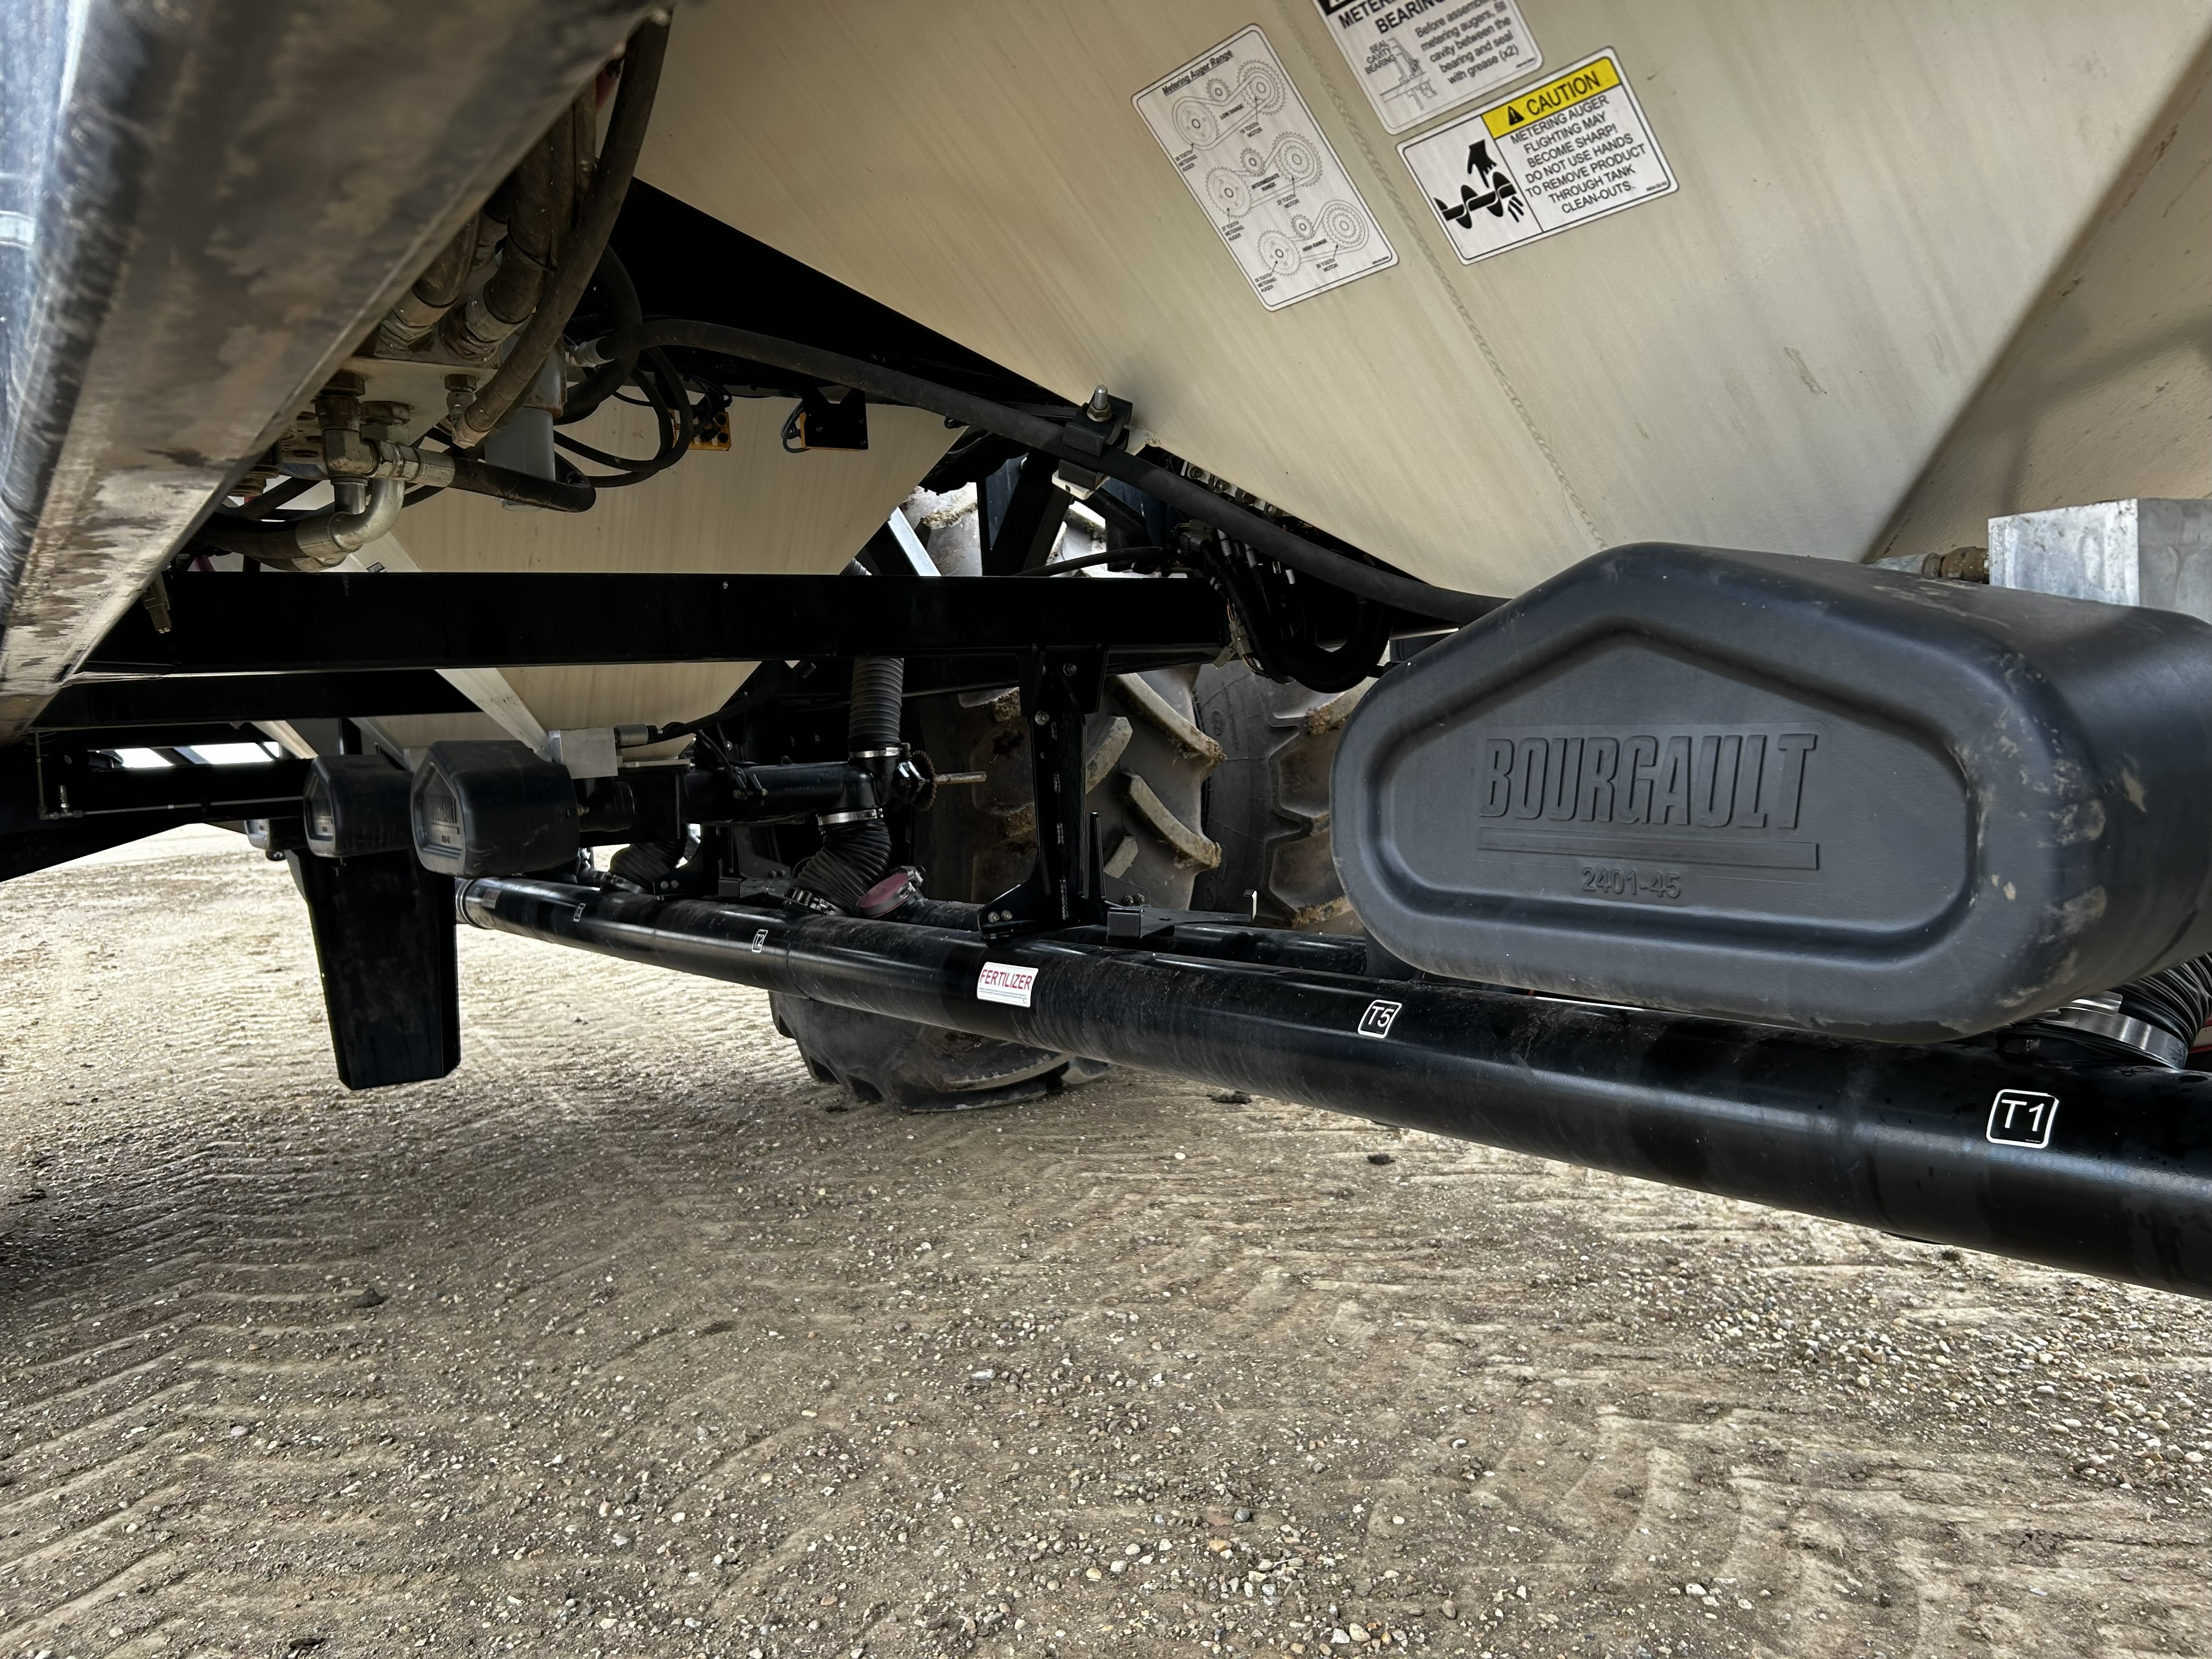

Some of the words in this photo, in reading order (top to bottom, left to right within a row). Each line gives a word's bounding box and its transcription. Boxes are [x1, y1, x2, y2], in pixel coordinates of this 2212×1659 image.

[1375, 0, 1444, 34] BEARIN
[1414, 18, 1446, 38] Before
[1367, 48, 1391, 64] CAVITY
[1369, 40, 1389, 53] SEAL
[1420, 27, 1460, 52] metering
[1429, 44, 1455, 63] cavity
[1454, 25, 1495, 49] between
[1493, 16, 1511, 30] the
[1438, 52, 1475, 73] bearing
[1474, 40, 1493, 57] and
[1493, 29, 1514, 47] seal
[1162, 75, 1190, 95] Metering
[1190, 64, 1210, 77] Auger
[1210, 50, 1233, 66] Range
[1364, 54, 1396, 75] BEARING
[1447, 70, 1466, 84] with
[1466, 55, 1499, 77] grease
[1498, 44, 1519, 61] (x2)
[1526, 70, 1601, 116] CAUTION
[1510, 112, 1567, 145] METERING
[1567, 94, 1610, 120] AUGER
[1523, 122, 1582, 154] FLIGHTING
[1582, 111, 1606, 129] MAY
[1525, 170, 1543, 184] DO
[1543, 159, 1566, 176] NOT
[1567, 149, 1593, 167] USE
[1592, 133, 1634, 156] HANDS
[1526, 142, 1575, 168] BECOME
[1575, 123, 1618, 149] SHARP!
[1525, 185, 1542, 198] TO
[1542, 166, 1590, 192] REMOVE
[1589, 143, 1645, 173] PRODUCT
[1548, 175, 1604, 203] THROUGH
[1603, 163, 1636, 182] TANK
[1561, 180, 1636, 213] CLEAN-OUTS.
[1480, 733, 1818, 830] BOURGAULT
[1582, 866, 1681, 899] 2401-45
[979, 969, 1032, 990] FERTILIZER
[1368, 1005, 1395, 1027] T5
[2001, 1099, 2045, 1132] T1
